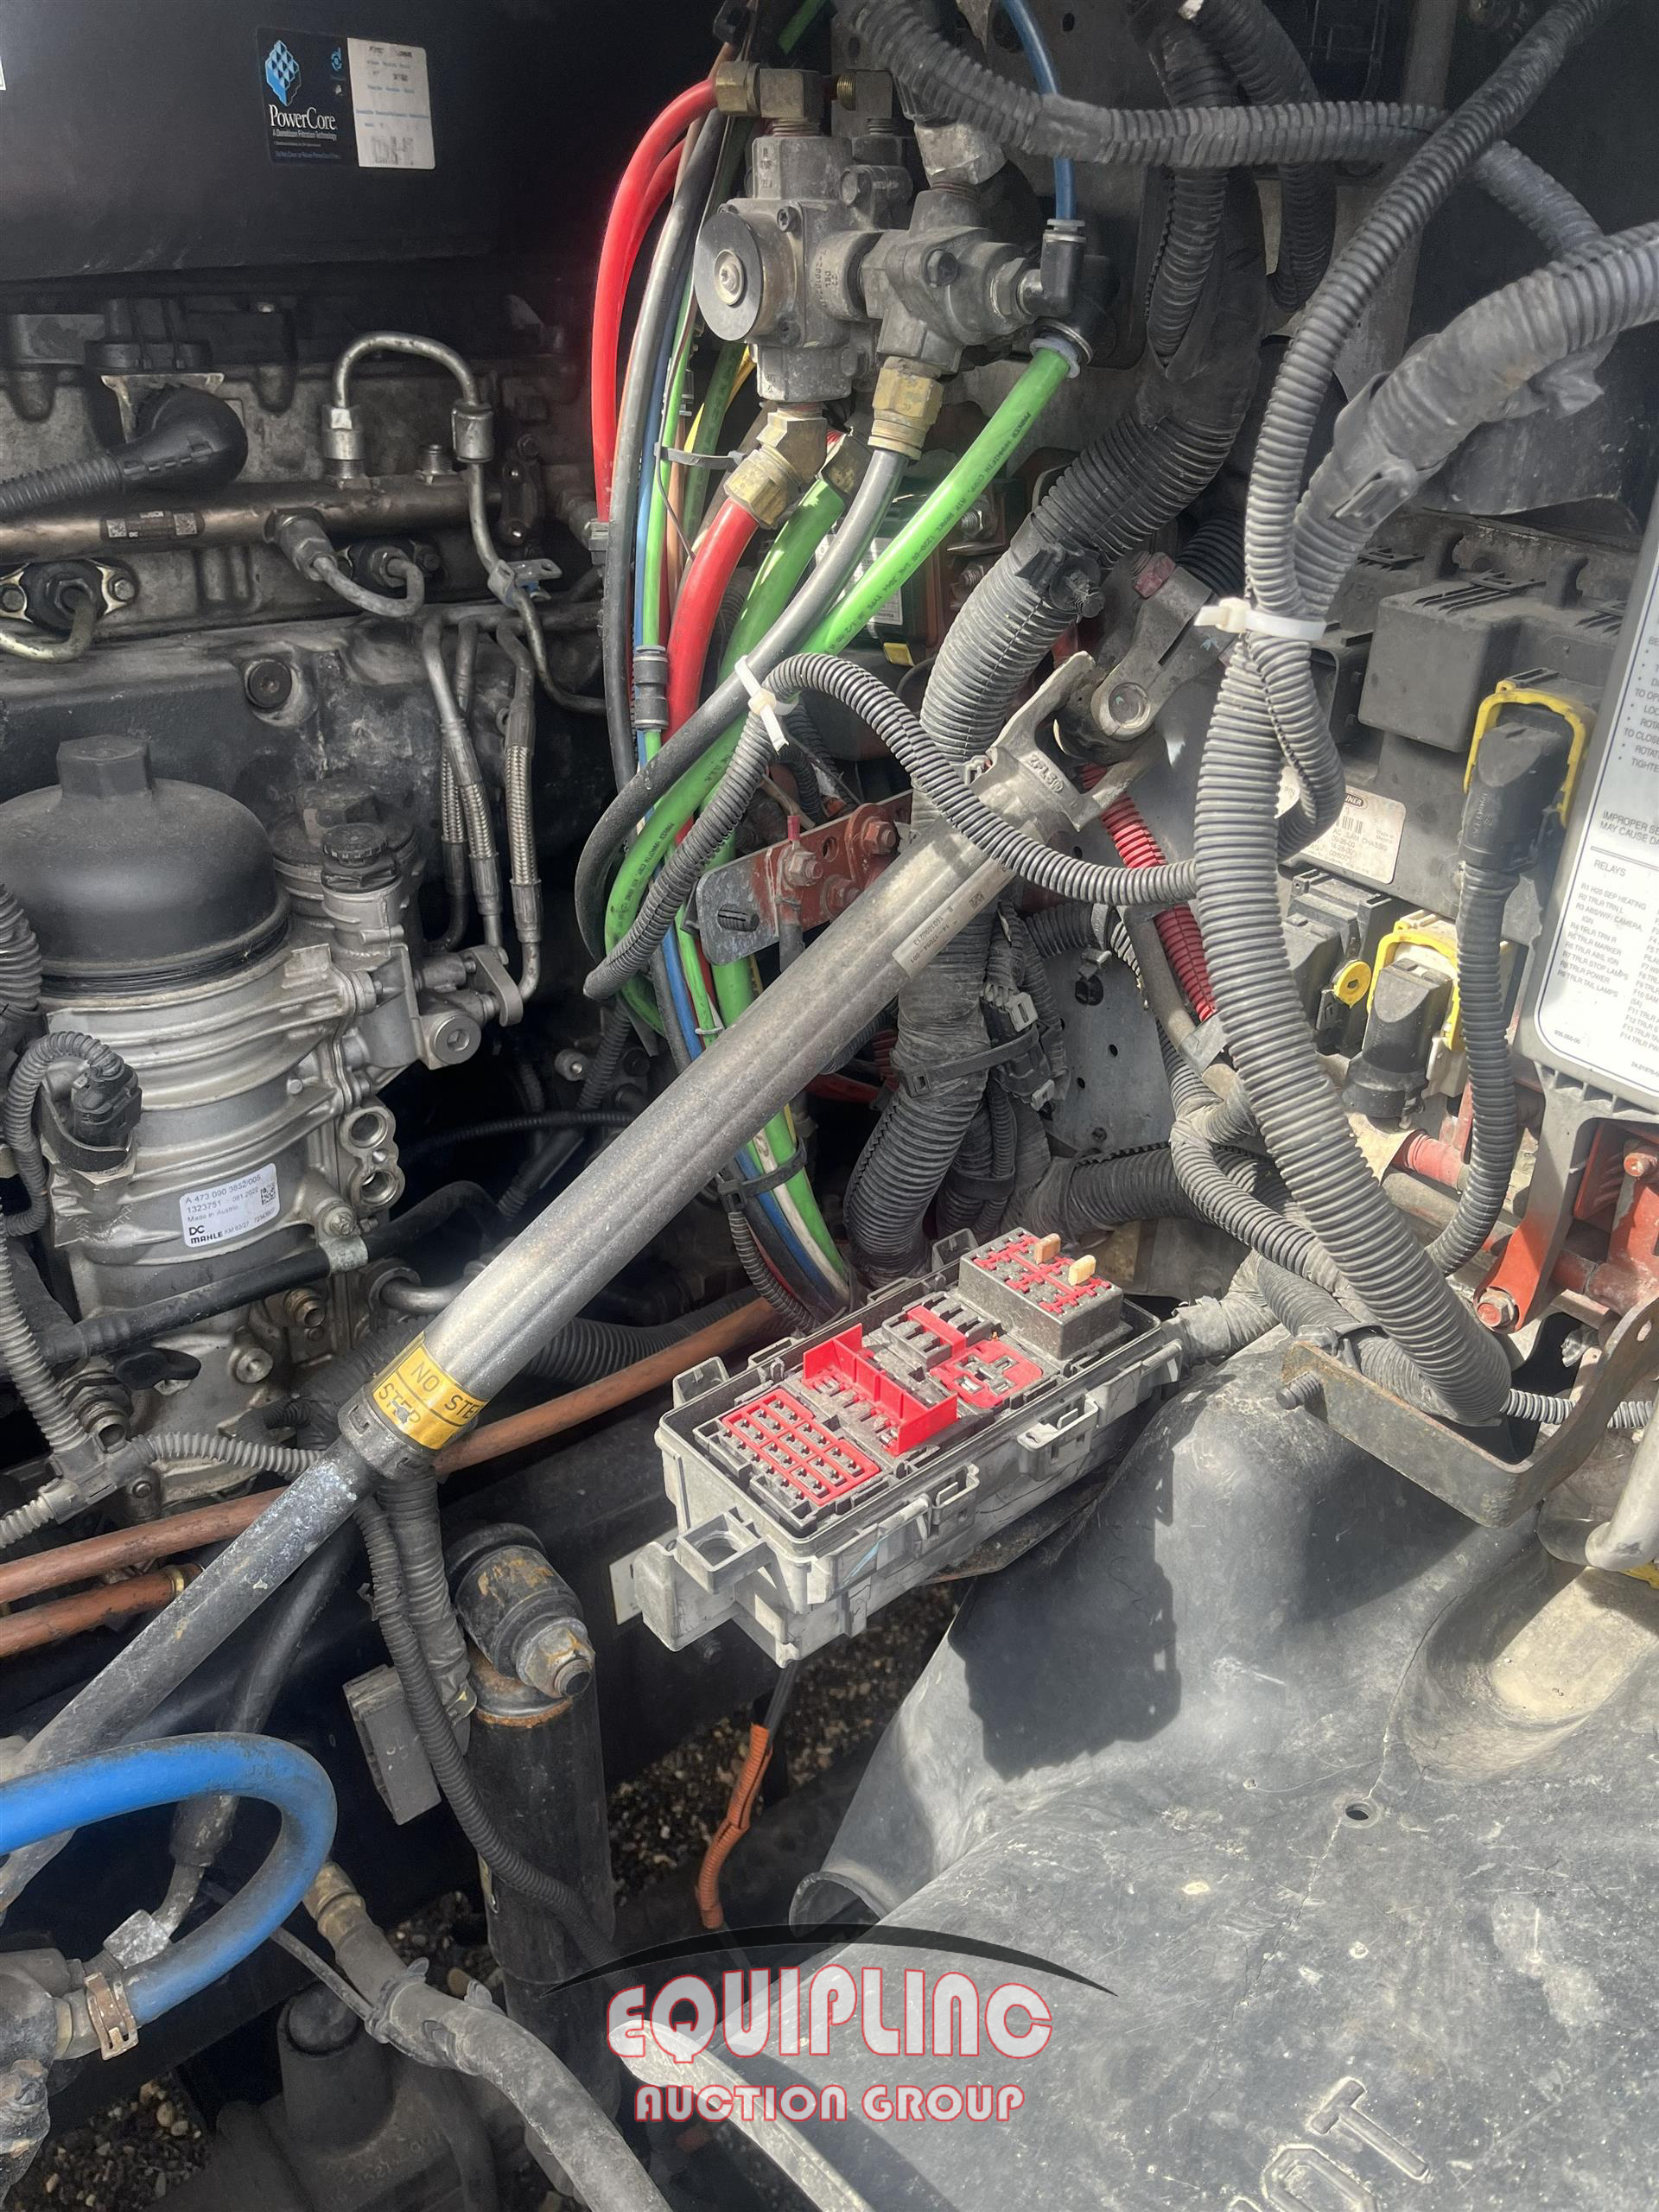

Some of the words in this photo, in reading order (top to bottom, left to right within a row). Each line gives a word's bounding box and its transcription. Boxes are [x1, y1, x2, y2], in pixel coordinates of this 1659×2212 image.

[269, 104, 336, 130] PowerCore
[1635, 688, 1646, 698] TO
[1624, 728, 1635, 738] TO
[1603, 810, 1648, 832] IMPROPER
[1600, 820, 1618, 833] MAY
[1619, 825, 1648, 843] CAUSE
[1593, 859, 1626, 877] RELAYS
[1578, 893, 1587, 901] R2
[1588, 896, 1605, 907] TRLR
[1604, 890, 1618, 899] SEP
[1618, 895, 1647, 911] HEATING
[1594, 941, 1622, 957] MARKER
[1589, 959, 1606, 971] STOP
[1586, 969, 1611, 984] POWER
[1596, 983, 1618, 997] LAMPS
[194, 1194, 210, 1203] 473
[212, 1189, 227, 1198] 090
[187, 1200, 221, 1214] 1323751
[188, 1214, 207, 1223] Made
[208, 1211, 215, 1219] in
[217, 1205, 239, 1216] Austria
[188, 1224, 205, 1236] DC
[190, 1231, 223, 1244] MAHLE
[410, 1361, 440, 1393] NO
